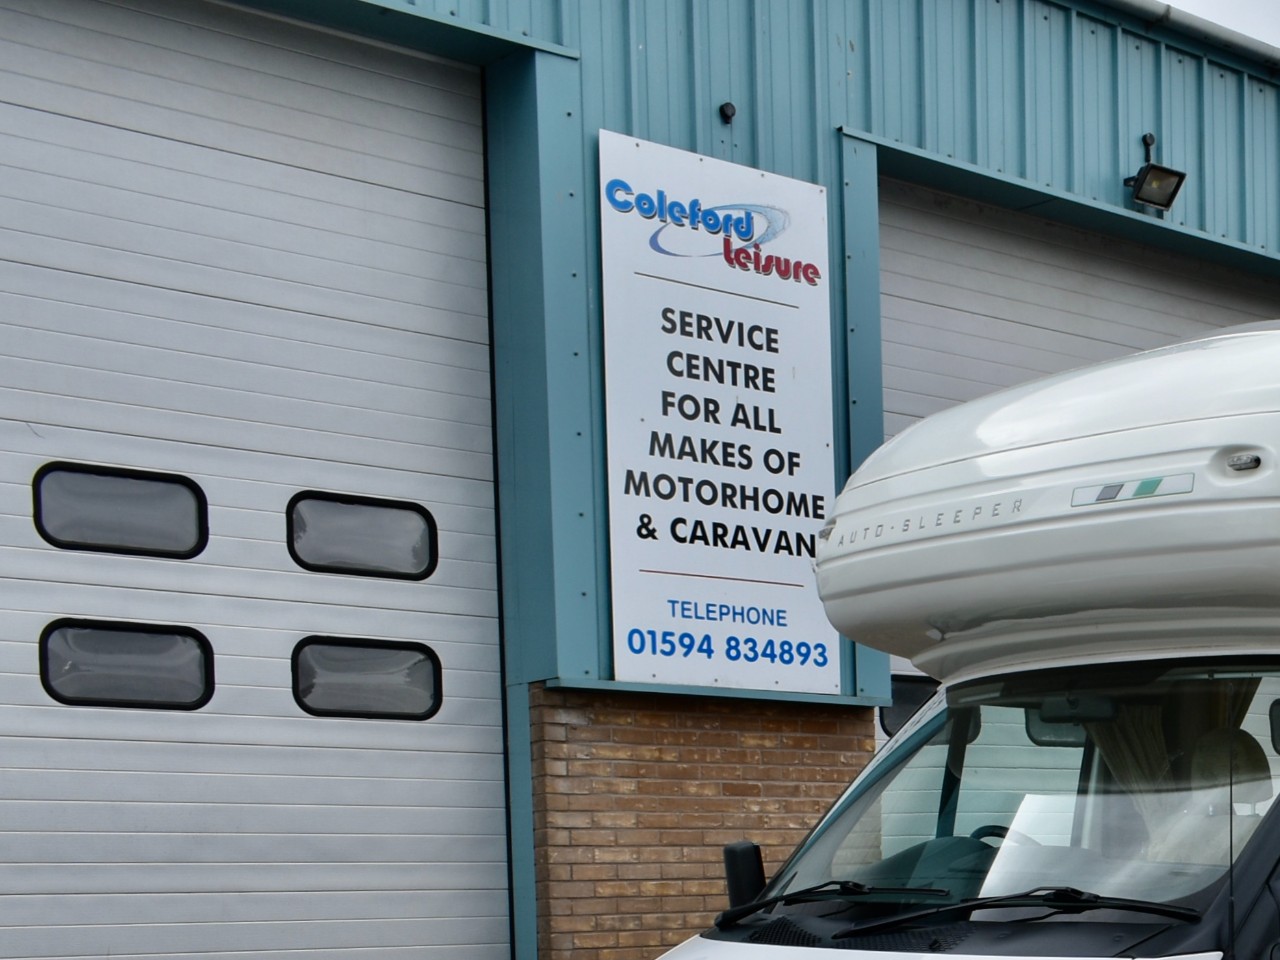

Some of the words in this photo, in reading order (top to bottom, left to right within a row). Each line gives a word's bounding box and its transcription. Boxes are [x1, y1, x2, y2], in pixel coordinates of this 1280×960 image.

[605, 178, 754, 241] Coleford
[723, 237, 821, 286] Leisure
[661, 307, 779, 353] SERVICE
[666, 351, 776, 393] CENTRE
[661, 390, 721, 424] FOR
[730, 402, 782, 434] ALL
[648, 430, 753, 470] MAKES
[763, 449, 801, 476] OF
[624, 469, 825, 520] MOTORHOME
[636, 513, 658, 540] &
[670, 517, 816, 558] CARAVAN
[667, 599, 788, 627] TELEPHONE
[627, 628, 714, 659] 01594
[725, 636, 828, 667] 834893
